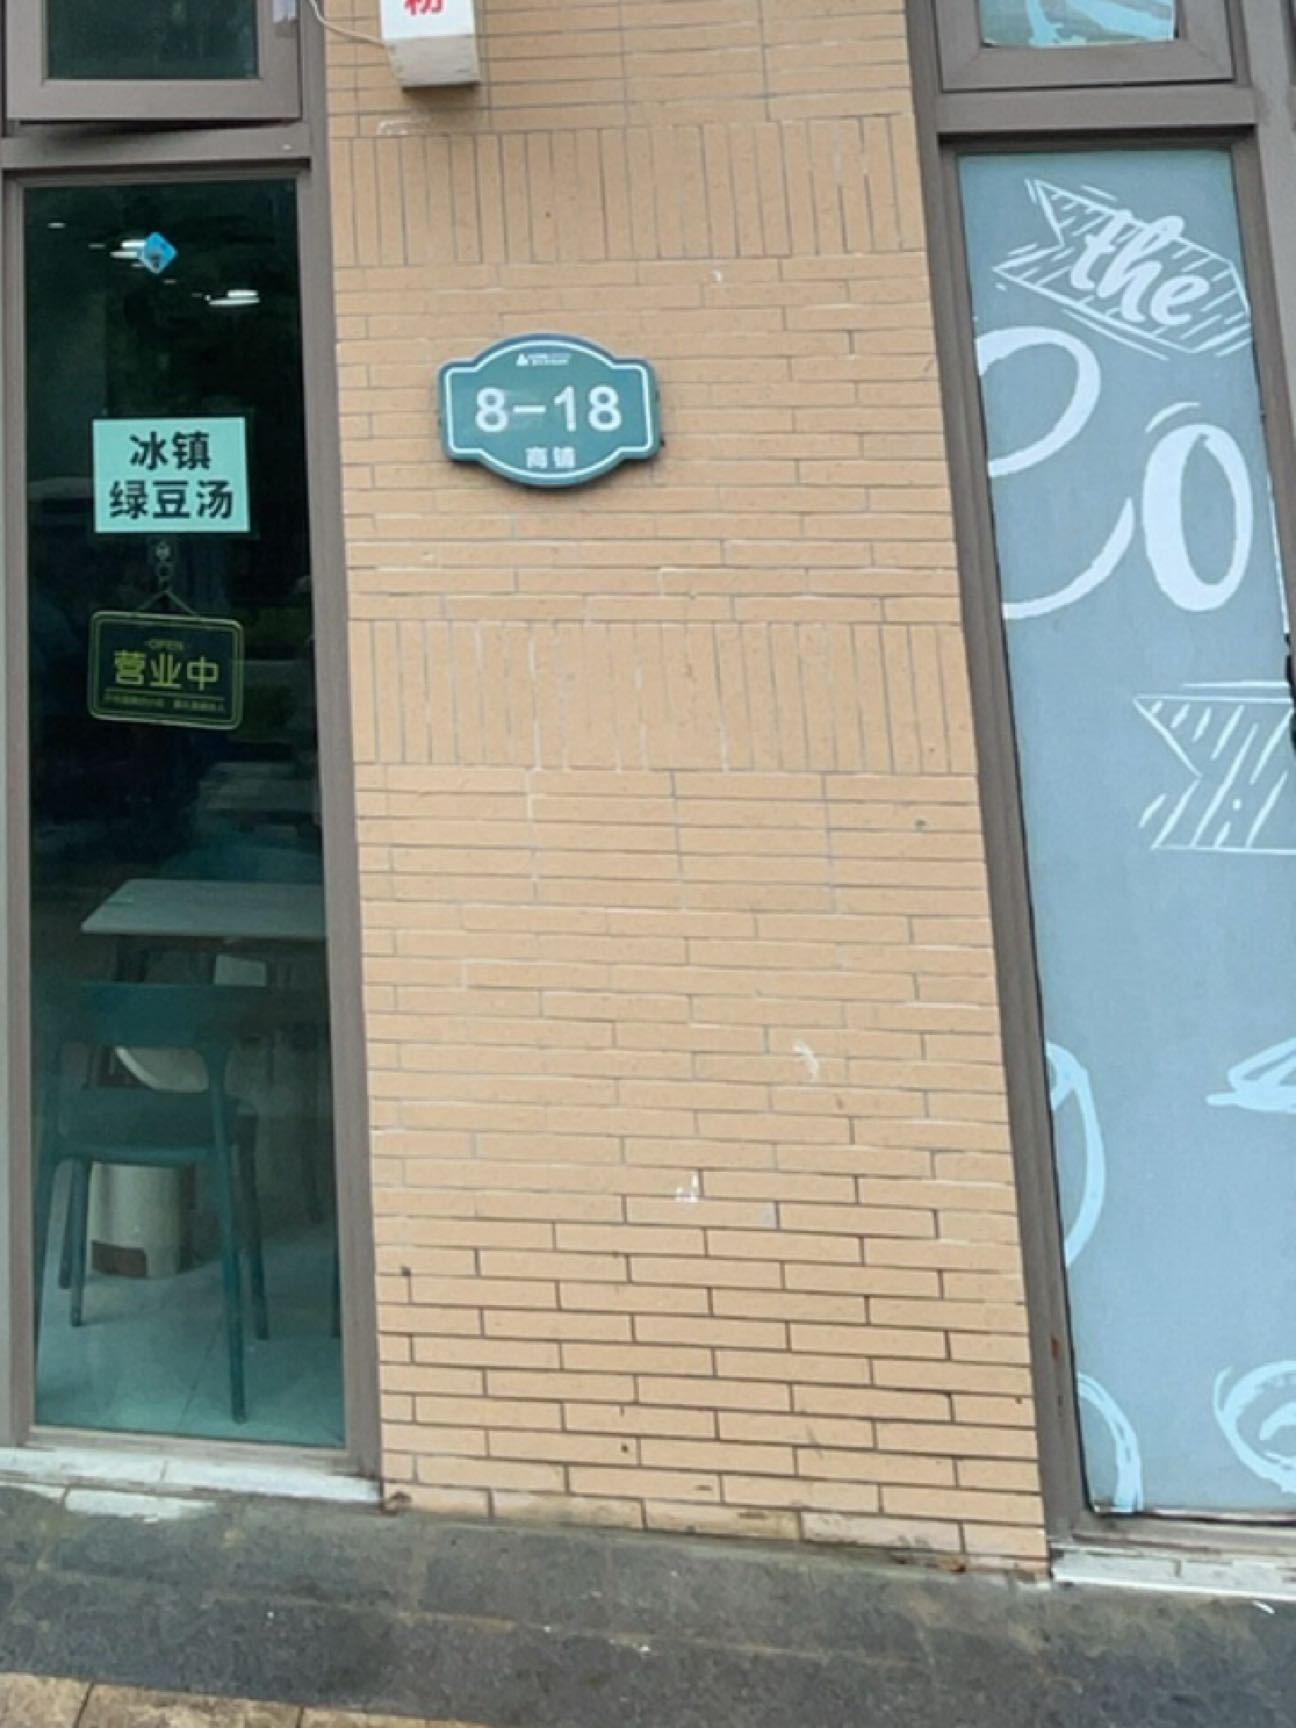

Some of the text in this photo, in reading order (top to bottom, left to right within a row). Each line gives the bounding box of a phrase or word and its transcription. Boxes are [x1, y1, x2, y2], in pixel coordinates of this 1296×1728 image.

[1071, 209, 1209, 325] the
[129, 431, 211, 472] 冰镇
[108, 479, 234, 520] 绿豆汤
[114, 650, 218, 691] 营业中
